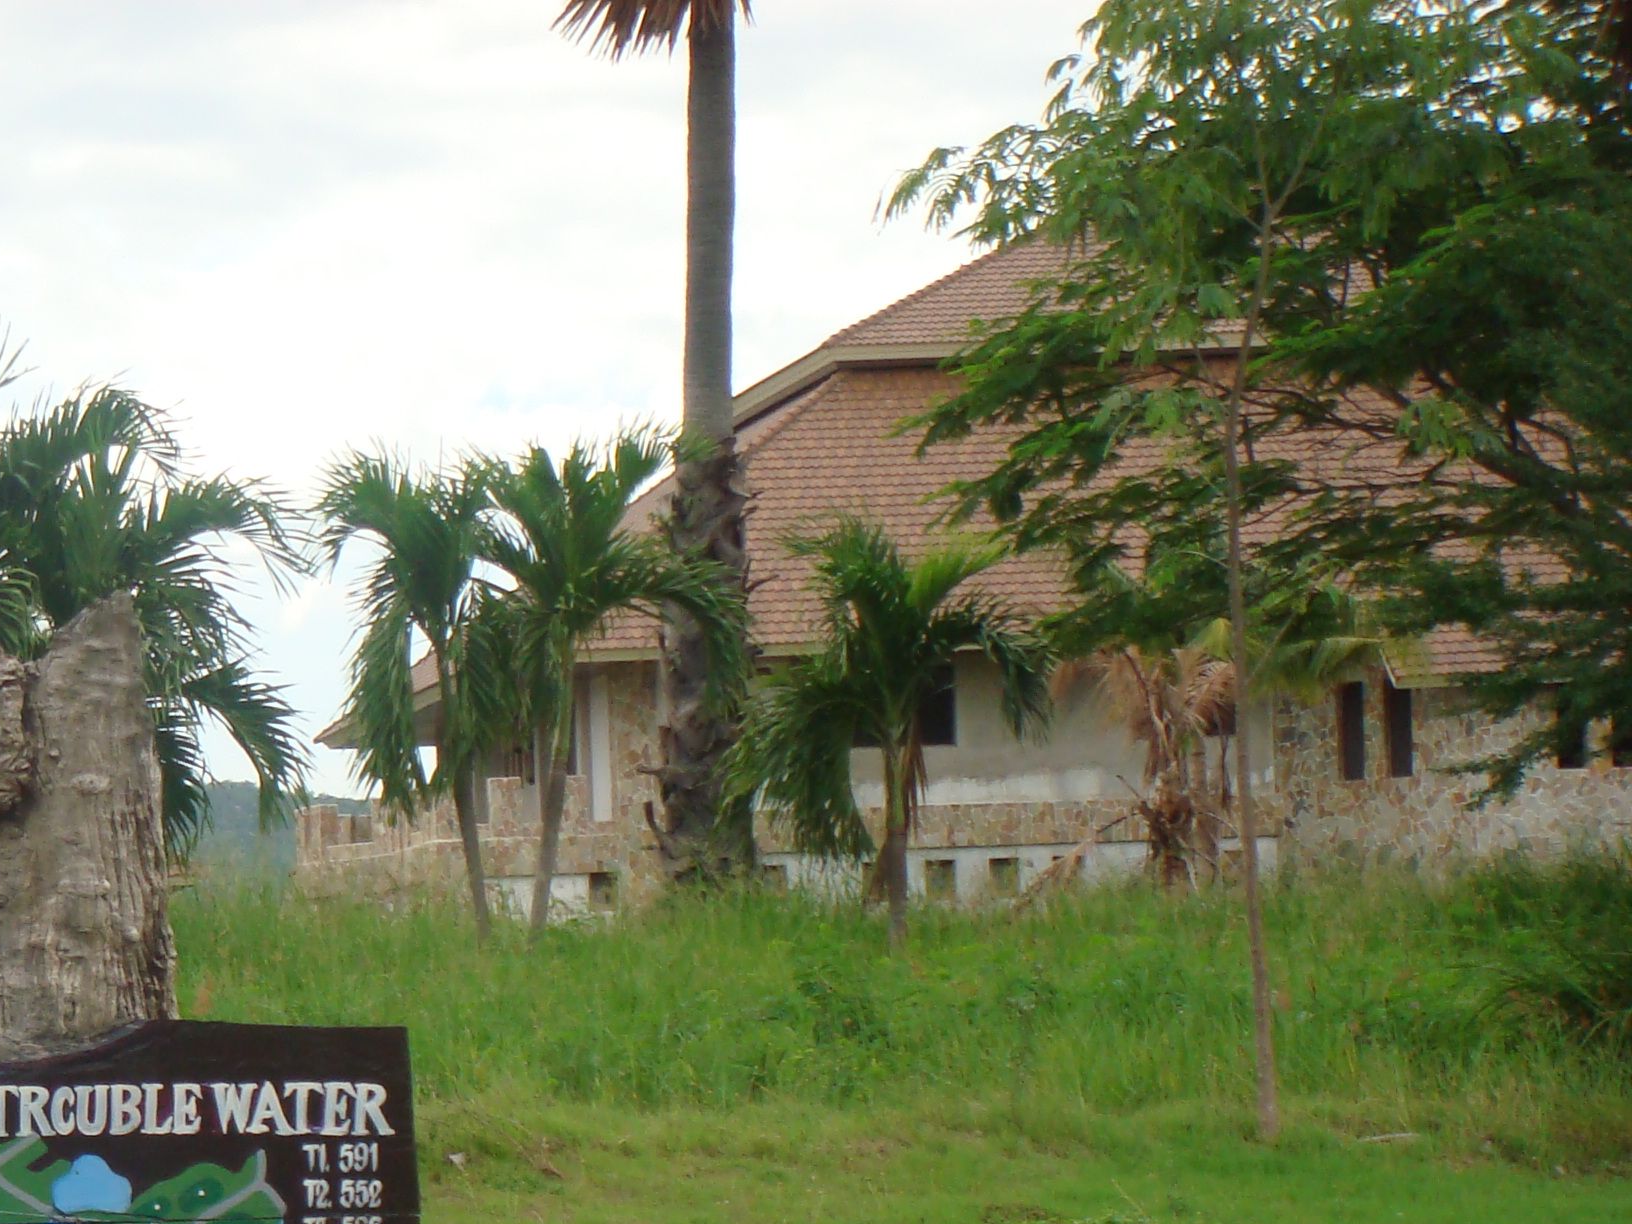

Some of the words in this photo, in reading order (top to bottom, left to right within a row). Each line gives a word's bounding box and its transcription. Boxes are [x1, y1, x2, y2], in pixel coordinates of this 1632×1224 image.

[210, 1080, 396, 1137] WATER
[338, 1142, 380, 1173] 591
[339, 1179, 384, 1208] 552
